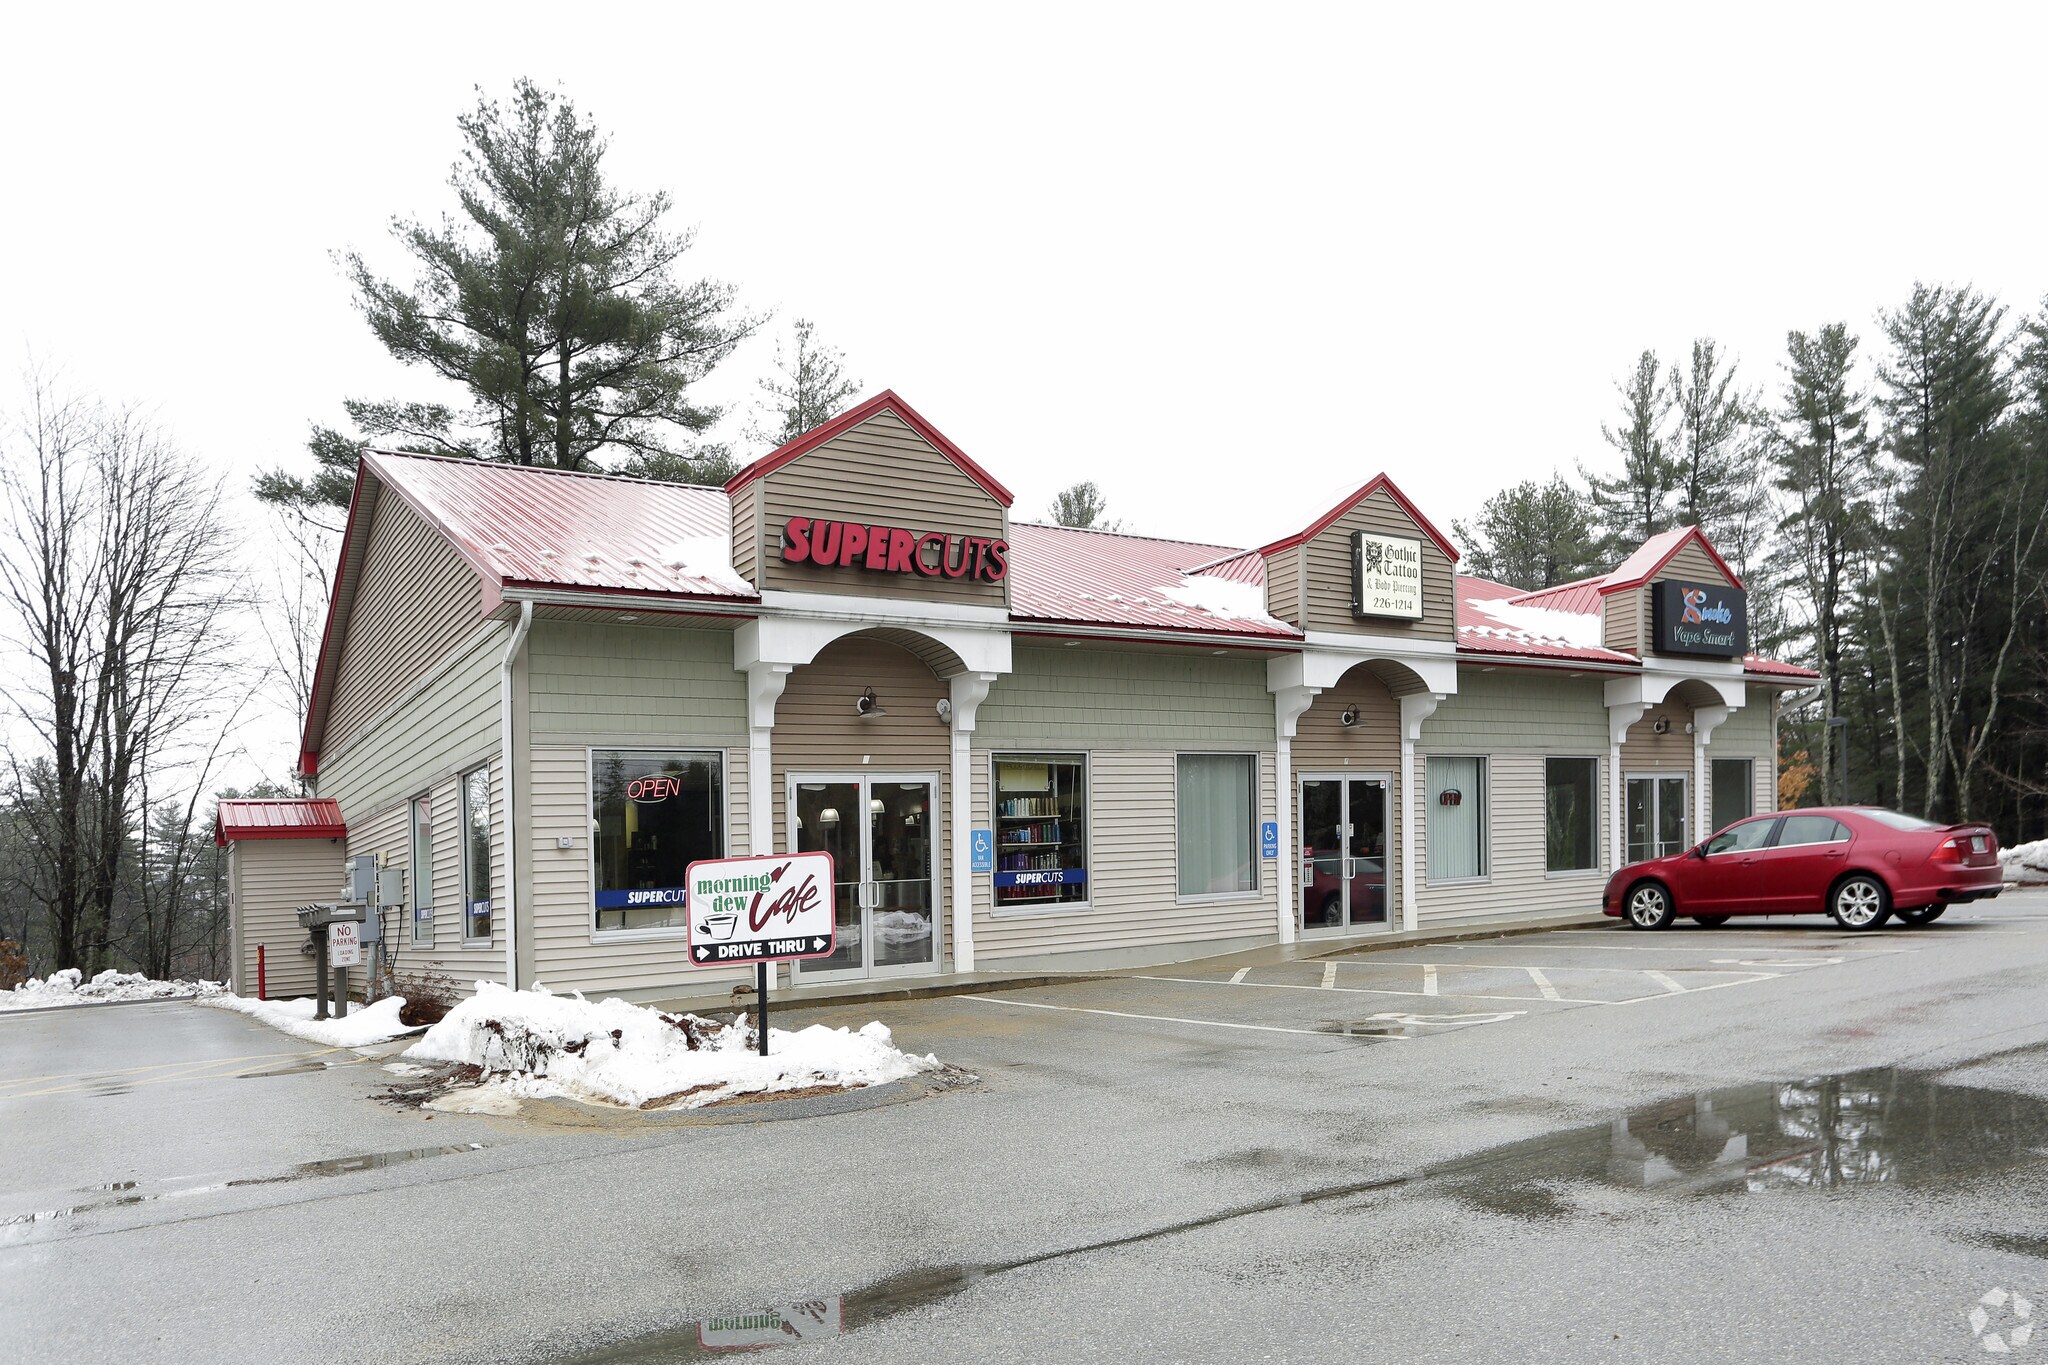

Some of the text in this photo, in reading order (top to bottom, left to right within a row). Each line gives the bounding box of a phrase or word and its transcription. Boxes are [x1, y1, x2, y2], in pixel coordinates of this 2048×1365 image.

[781, 517, 1010, 582] SUPERCUTS
[1385, 544, 1416, 562] Gothic
[1384, 560, 1417, 578] Tattoo
[1373, 597, 1413, 610] 226-1214
[1673, 625, 1735, 647] Vape Smart
[627, 778, 681, 799] OPEN
[697, 872, 772, 895] morning
[1015, 871, 1064, 885] SUPERCUTS
[627, 888, 686, 904] SUPERCUT
[712, 861, 822, 933] dew Cafe
[337, 926, 351, 936] NO
[332, 937, 357, 947] PARKING
[718, 939, 806, 959] DRIVE THRU
